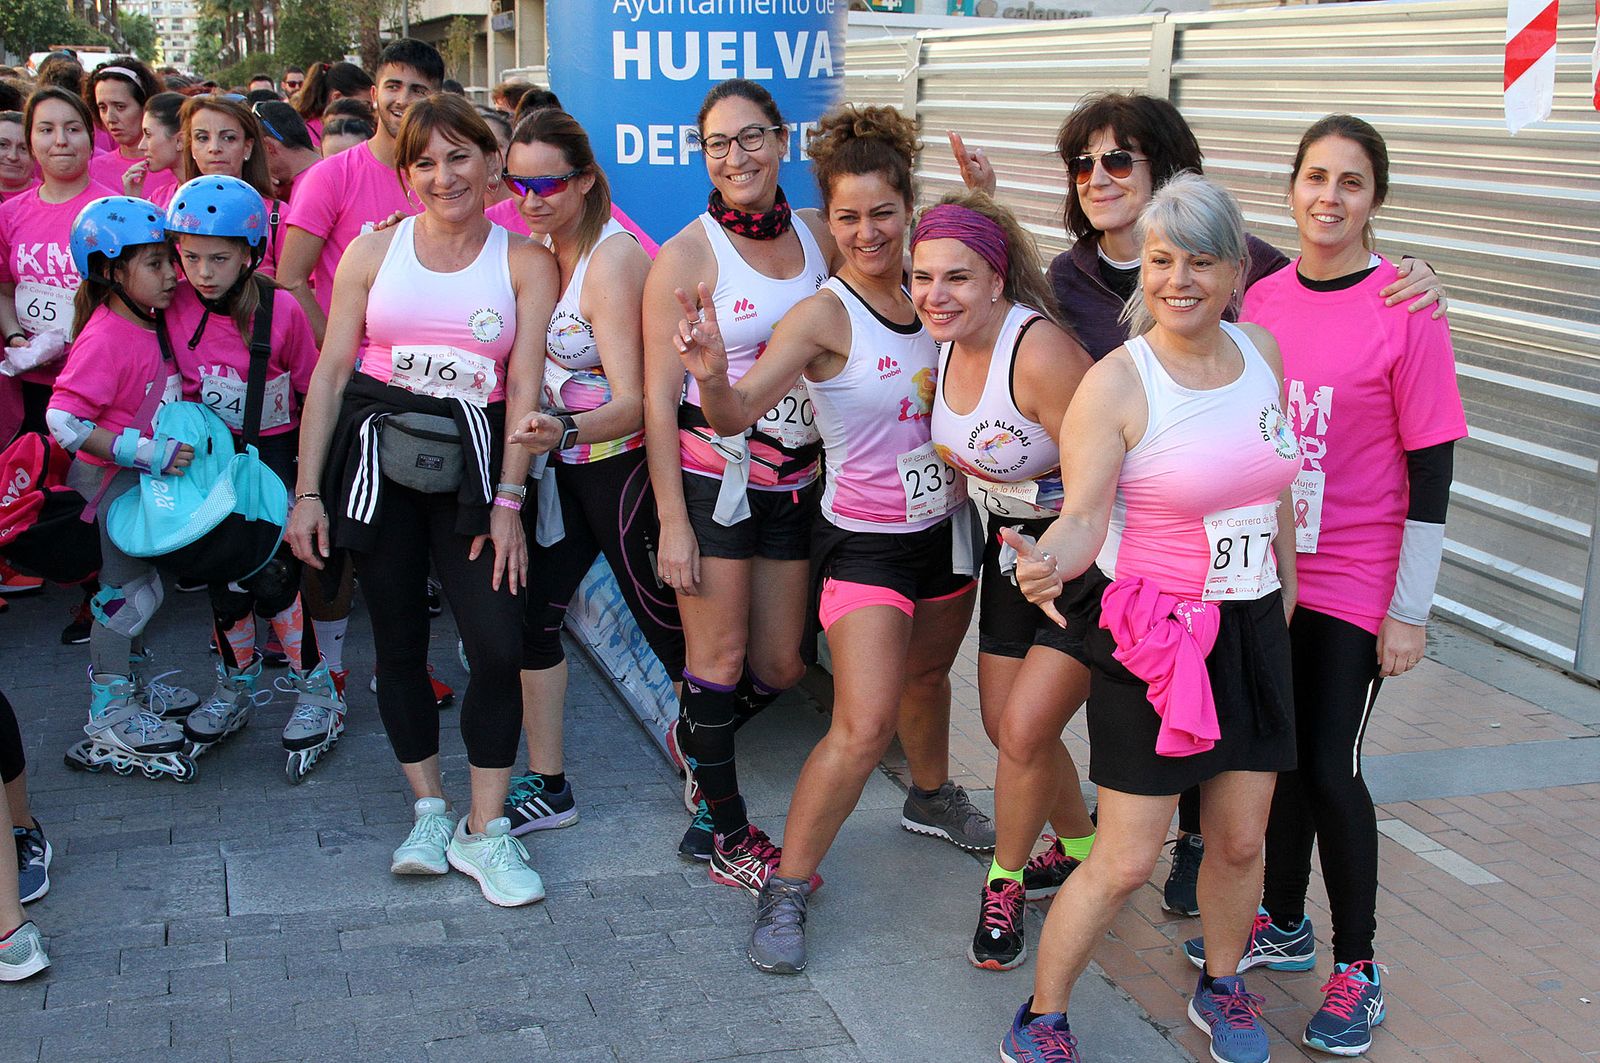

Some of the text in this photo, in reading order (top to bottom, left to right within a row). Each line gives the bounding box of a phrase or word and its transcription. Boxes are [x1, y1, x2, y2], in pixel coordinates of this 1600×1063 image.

[612, 0, 834, 21] Ayuntamiento de
[612, 30, 835, 80] HUELVA
[17, 242, 79, 275] KM
[27, 297, 57, 321] 65
[735, 311, 758, 323] mobel
[396, 350, 457, 381] 316
[880, 368, 902, 380] mobel
[207, 391, 241, 414] 24
[967, 419, 1032, 450] DIOSAS ALADAS
[1259, 406, 1271, 442] DIOSAS
[974, 455, 1029, 474] RUNNER CLUB
[1010, 485, 1033, 496] Mujer
[1291, 478, 1318, 490] Mujer
[1226, 516, 1261, 528] Carrera
[1213, 532, 1272, 570] 817
